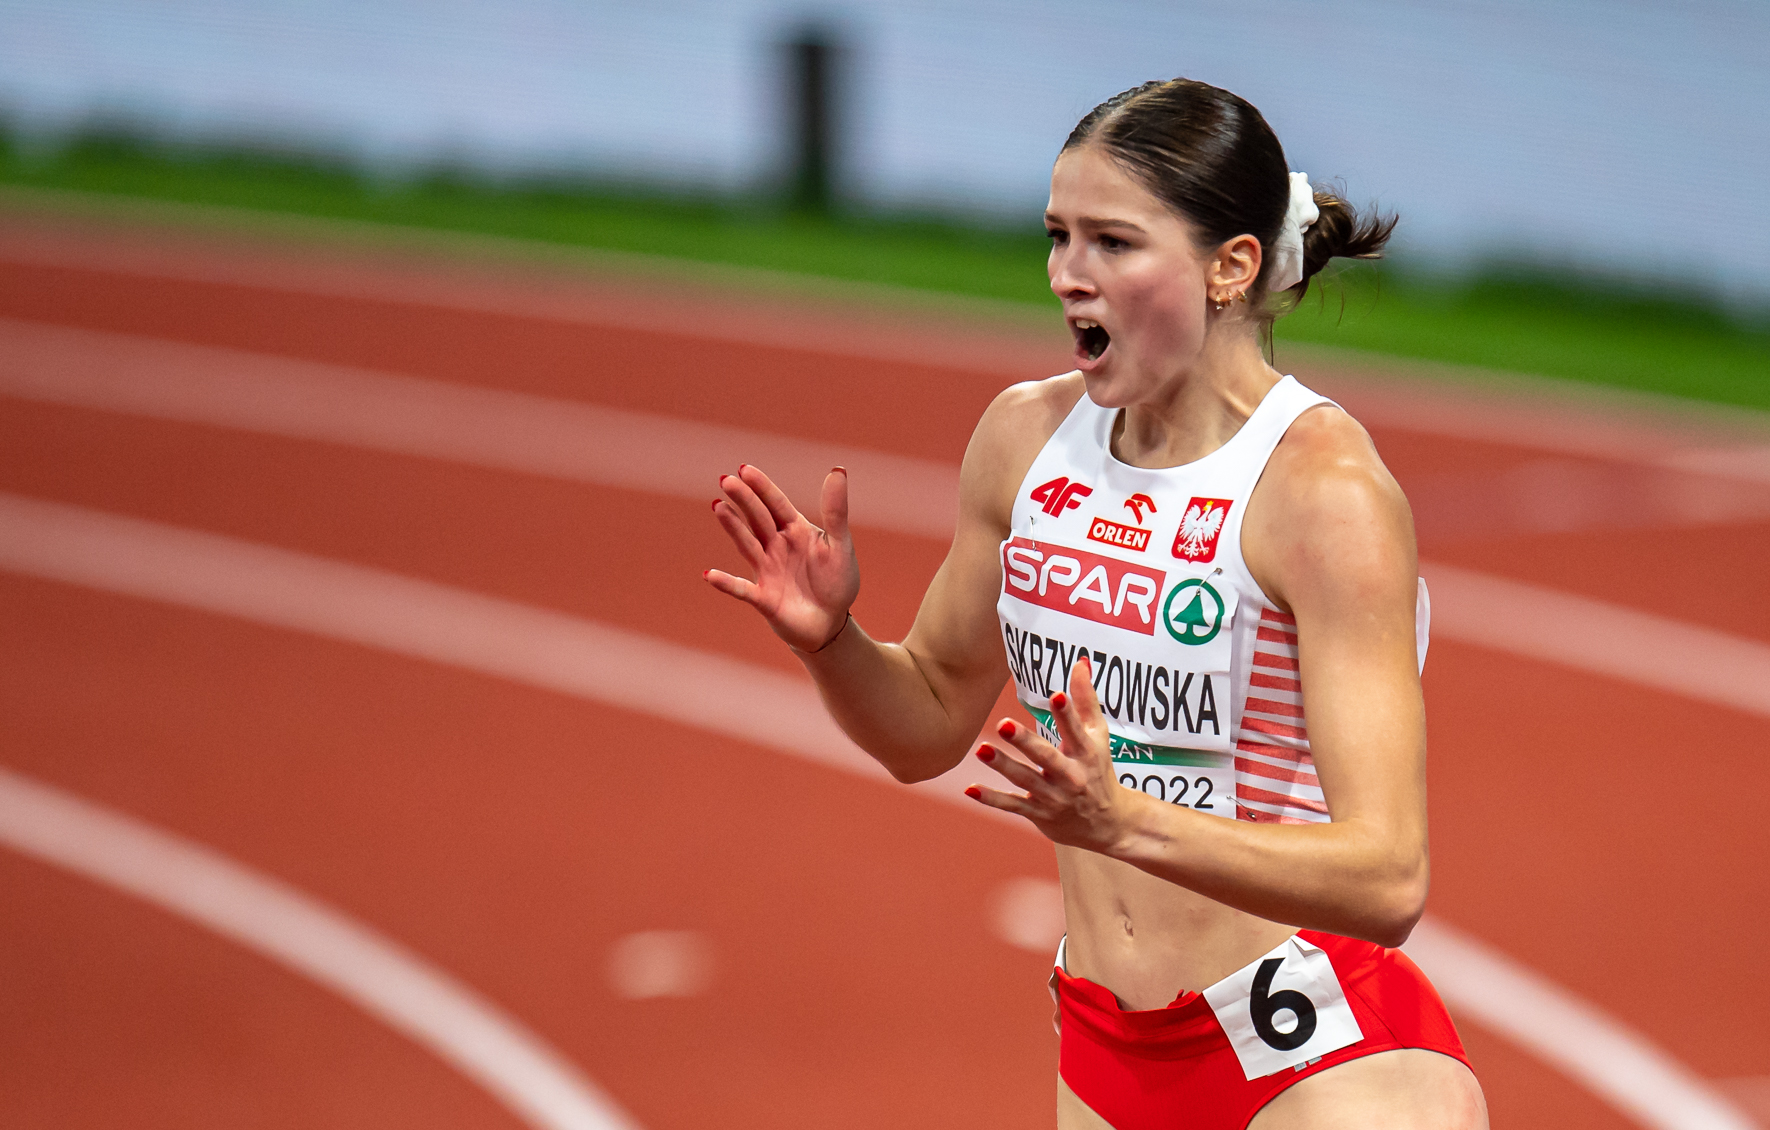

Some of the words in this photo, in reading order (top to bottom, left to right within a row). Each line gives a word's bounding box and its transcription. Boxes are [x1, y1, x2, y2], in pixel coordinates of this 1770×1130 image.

[1030, 476, 1094, 519] 4F
[1092, 522, 1147, 549] ORLEN
[1006, 546, 1157, 624] SPAR
[1005, 622, 1221, 736] SKRZYZOWSKA
[1249, 957, 1318, 1052] 6
